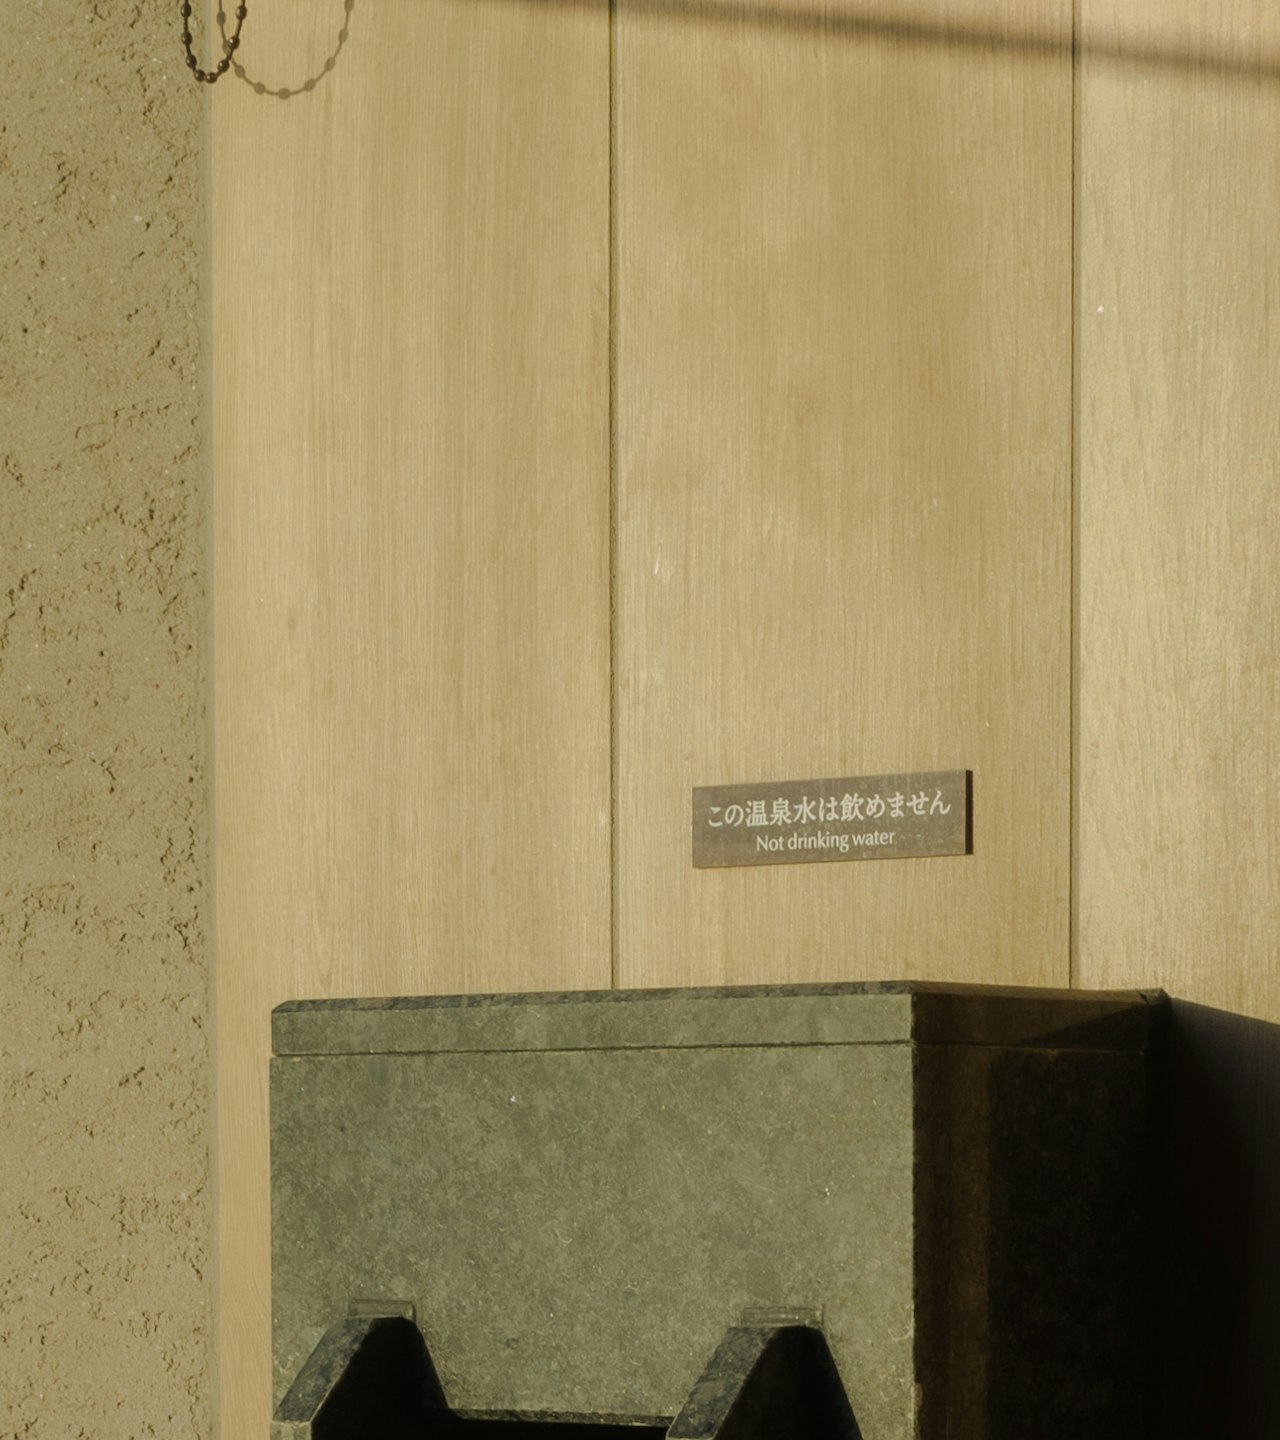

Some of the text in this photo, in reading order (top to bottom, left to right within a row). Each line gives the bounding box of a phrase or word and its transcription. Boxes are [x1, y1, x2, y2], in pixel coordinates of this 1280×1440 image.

[708, 790, 951, 827] この温泉水は飲めません
[756, 831, 895, 852] Not drinking water
